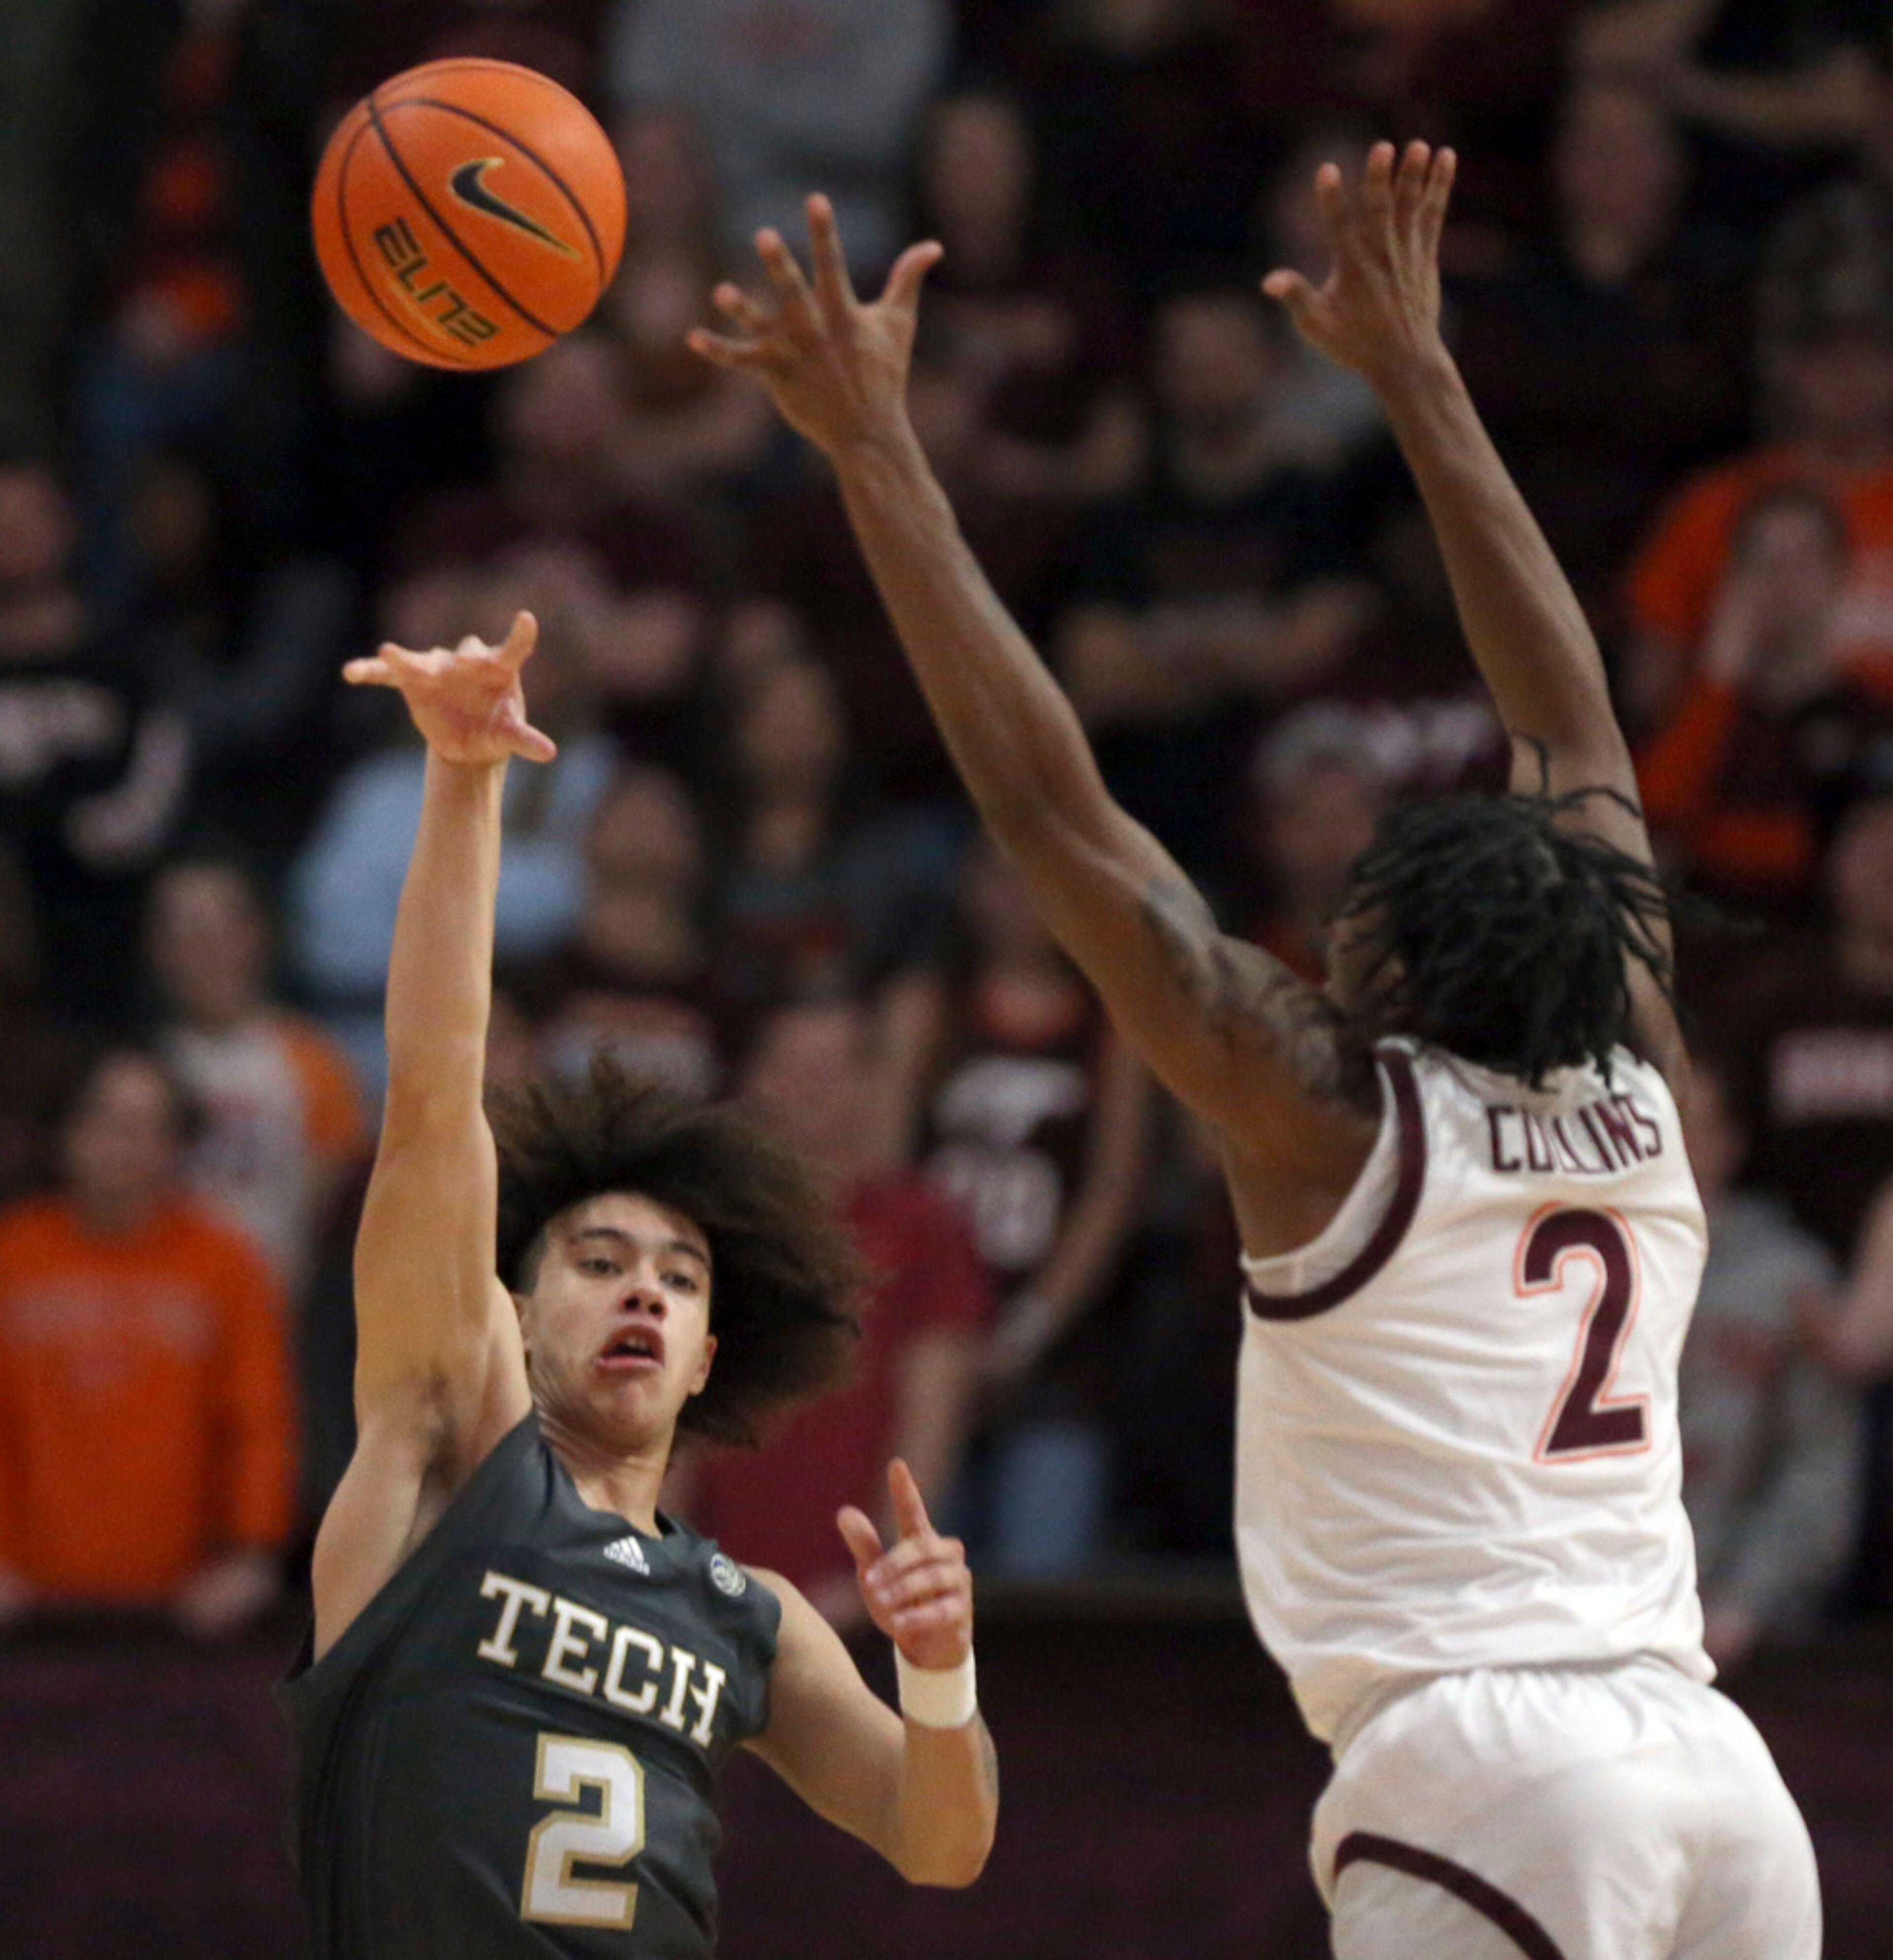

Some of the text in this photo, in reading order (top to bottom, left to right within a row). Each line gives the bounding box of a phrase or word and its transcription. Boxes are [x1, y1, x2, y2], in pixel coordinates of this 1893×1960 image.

[373, 216, 501, 347] ELITE
[1512, 1200, 1652, 1467] 2
[477, 1569, 727, 1749] TECH
[520, 1732, 645, 1932] 2
